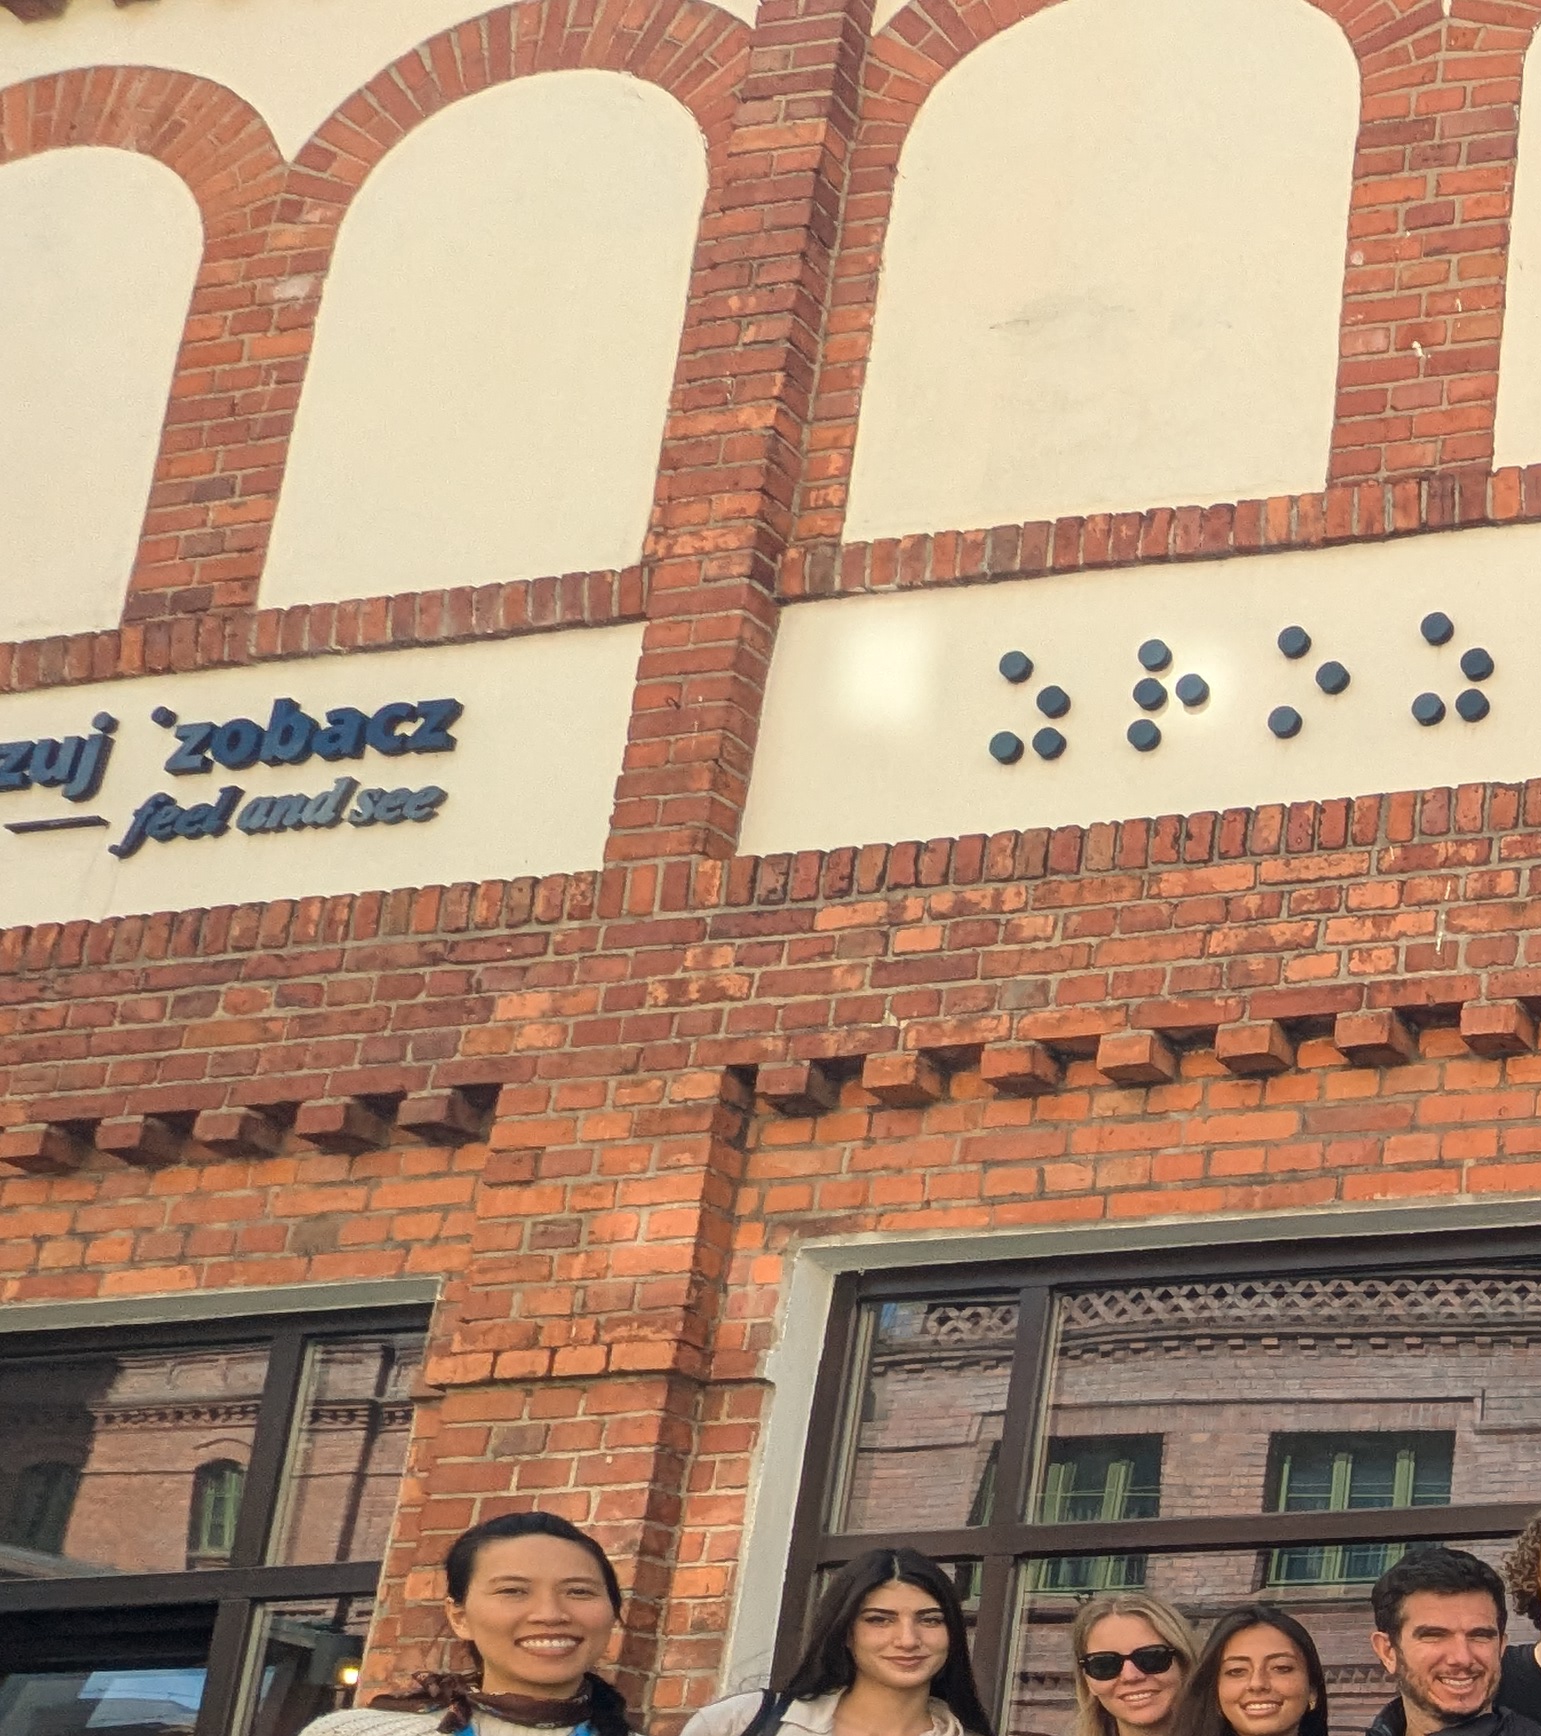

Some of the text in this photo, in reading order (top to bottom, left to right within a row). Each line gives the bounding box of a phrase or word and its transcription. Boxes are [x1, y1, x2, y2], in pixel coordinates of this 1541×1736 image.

[107, 776, 448, 859] feel and see
